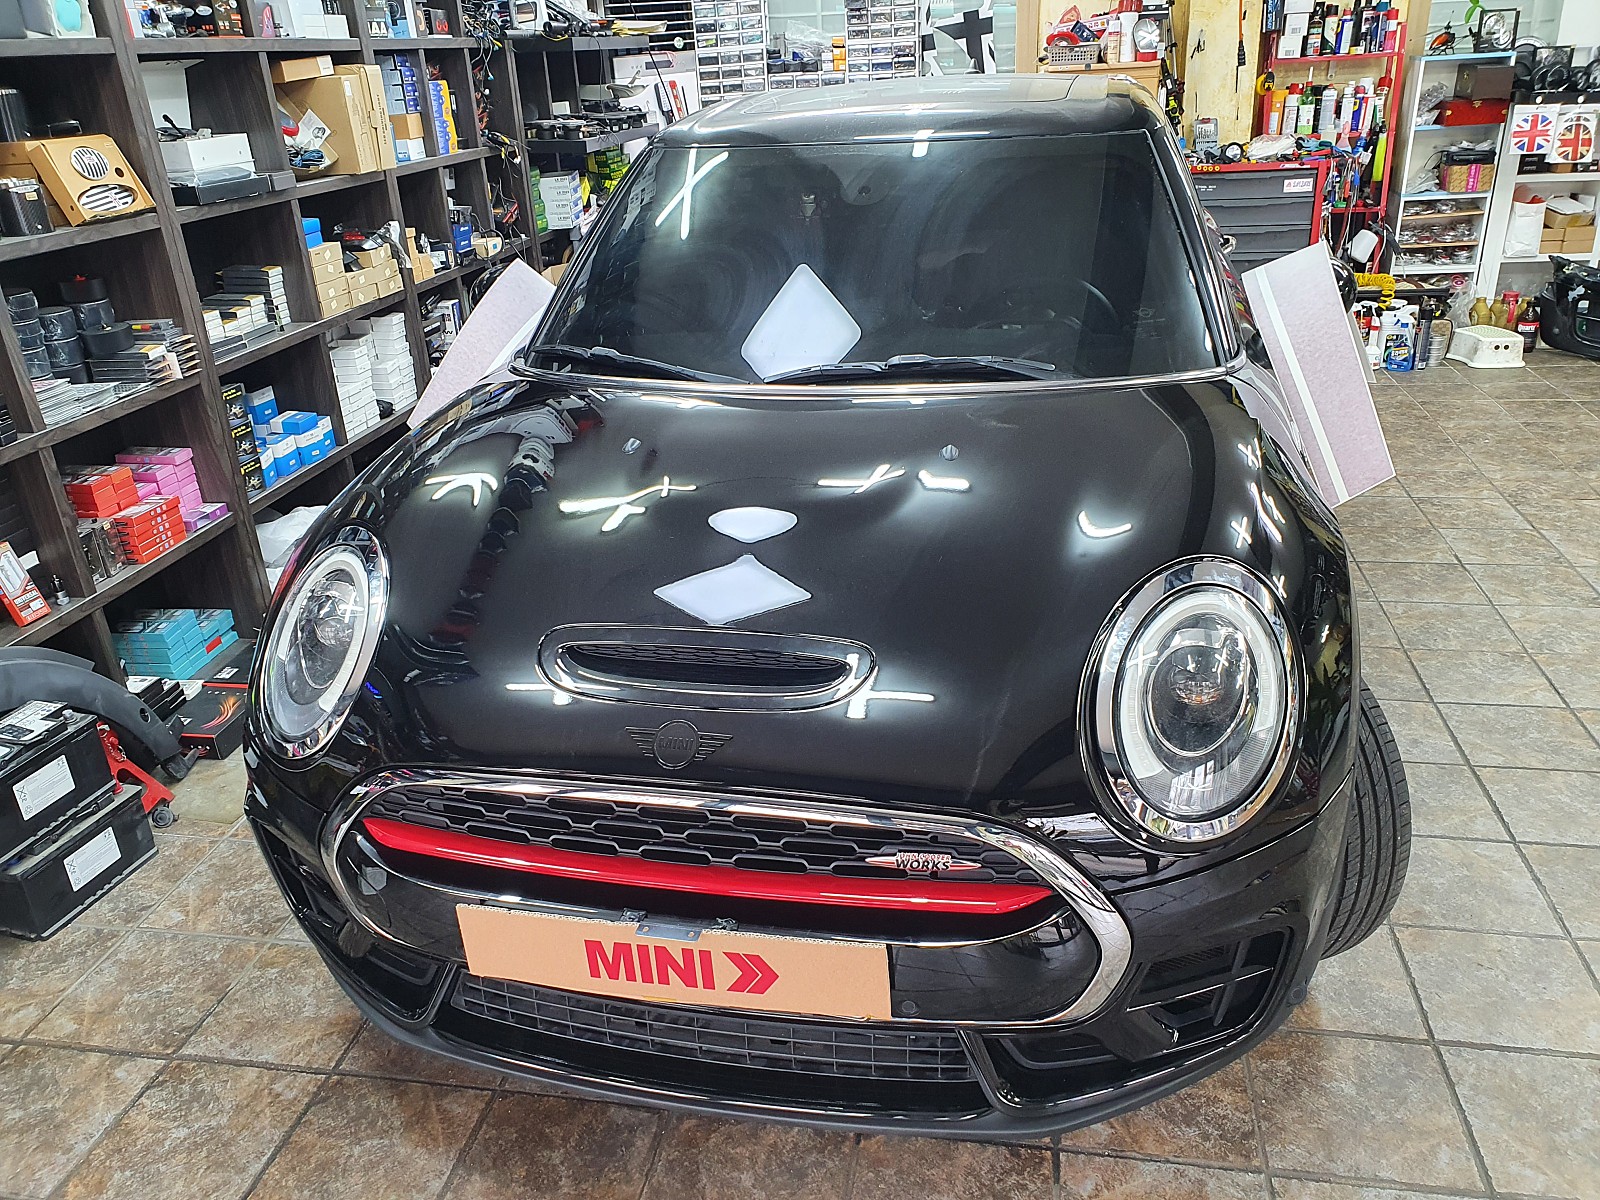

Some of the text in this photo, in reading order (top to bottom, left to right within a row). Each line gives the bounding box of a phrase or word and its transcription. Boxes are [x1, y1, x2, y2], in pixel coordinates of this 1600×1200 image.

[659, 736, 694, 751] MINI
[895, 852, 951, 861] JOHN COOPER
[896, 859, 950, 871] WORKS
[584, 939, 716, 990] MINI
